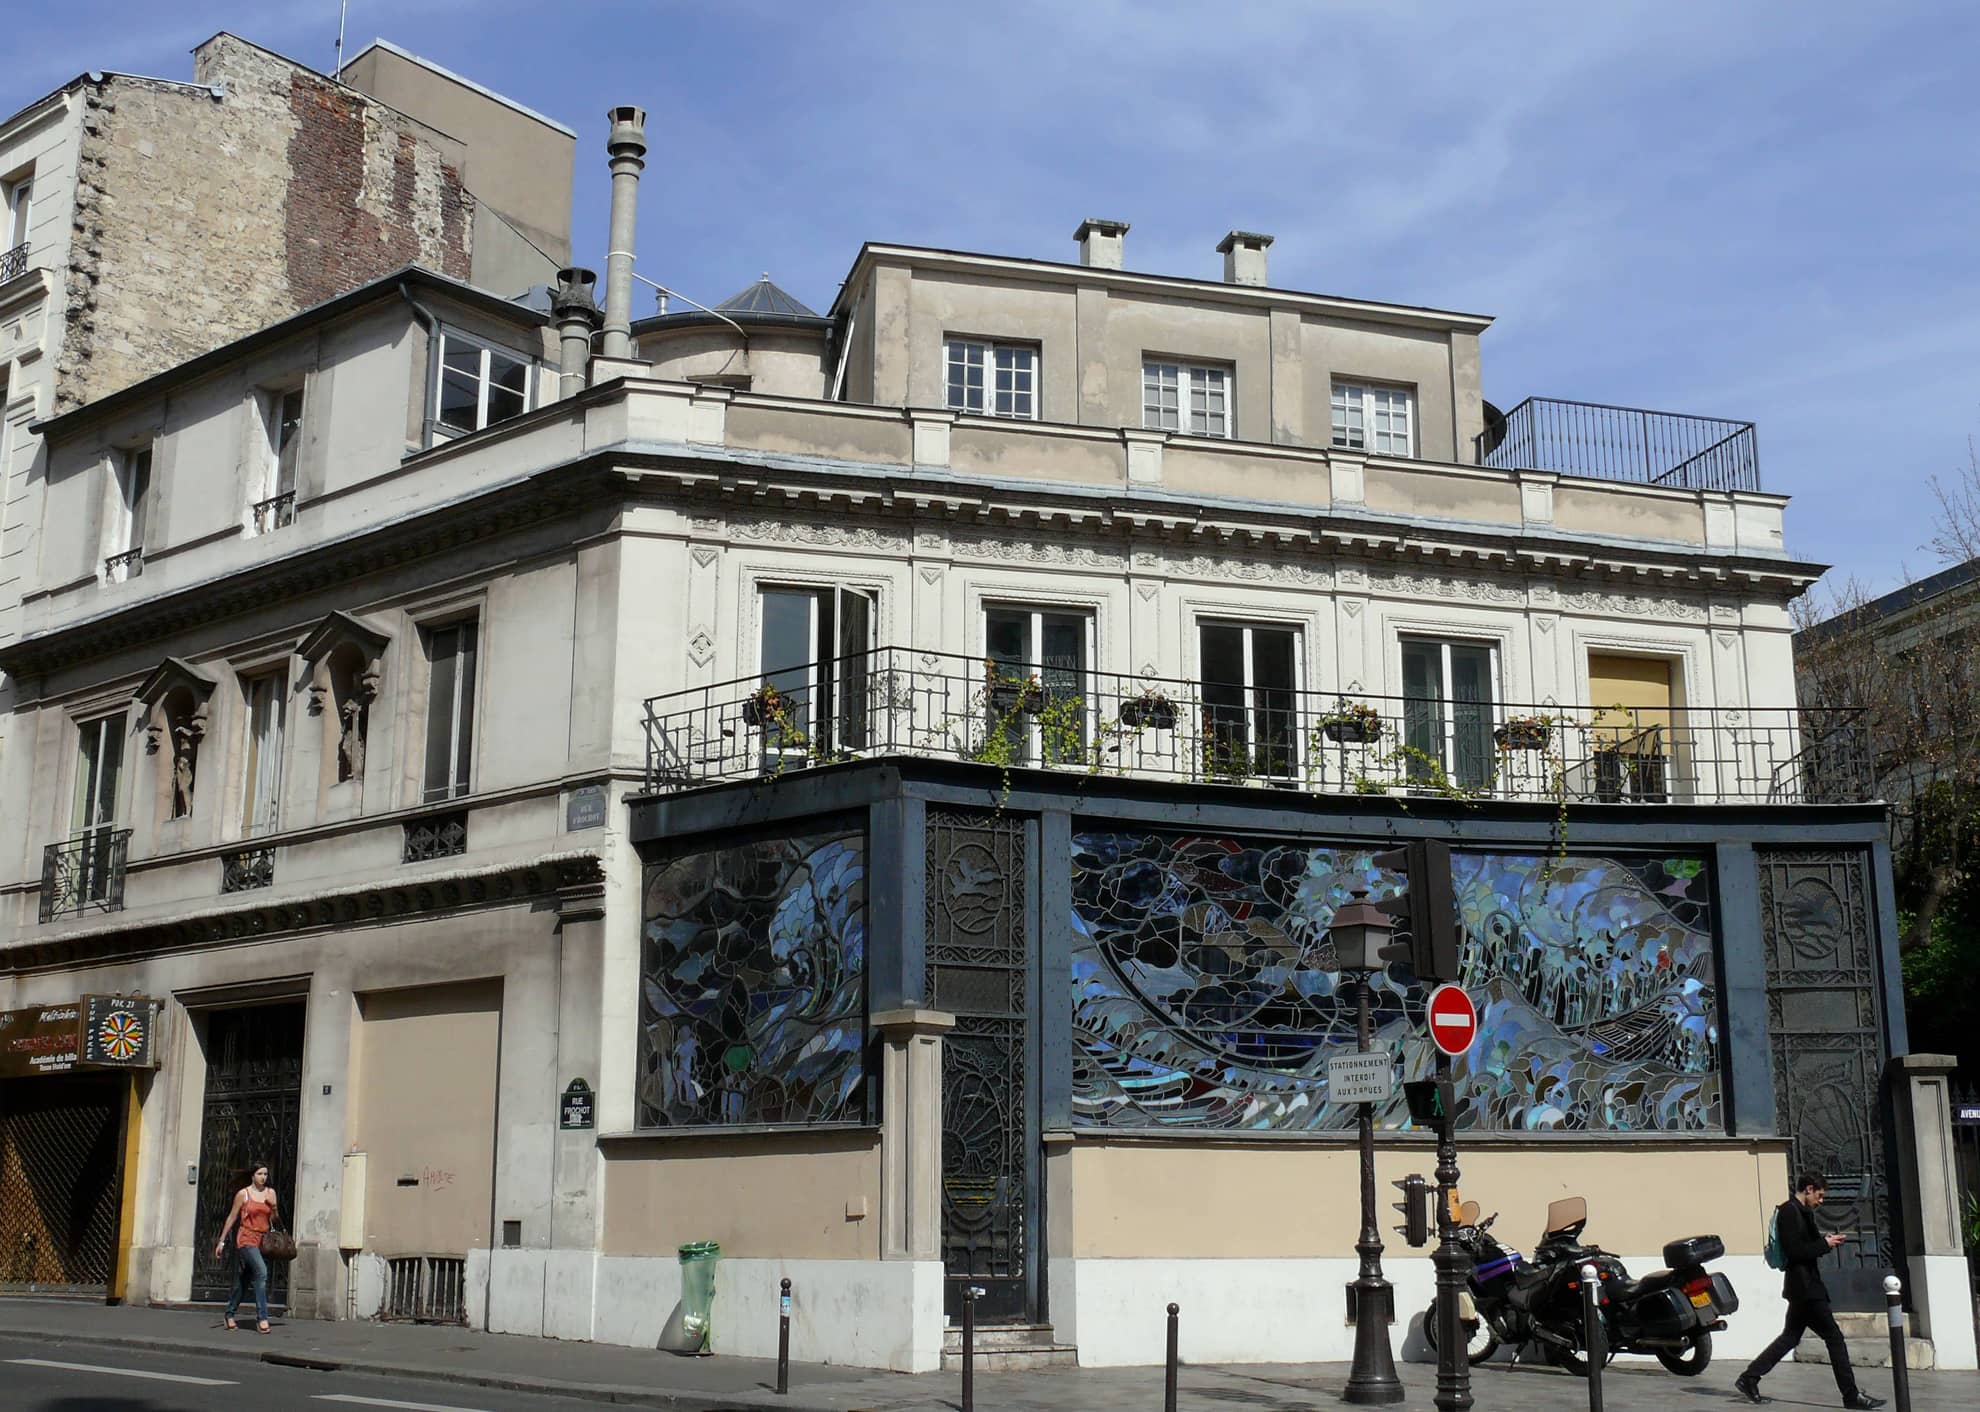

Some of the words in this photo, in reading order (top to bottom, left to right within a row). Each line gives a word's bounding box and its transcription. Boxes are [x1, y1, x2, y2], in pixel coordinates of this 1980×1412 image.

[1330, 1059, 1387, 1070] STATIONNEMENT
[1344, 1073, 1375, 1082] INTERDIT
[1337, 1088, 1350, 1096] AUX
[572, 1097, 583, 1105] RUE
[564, 1106, 591, 1115] FROCHOT
